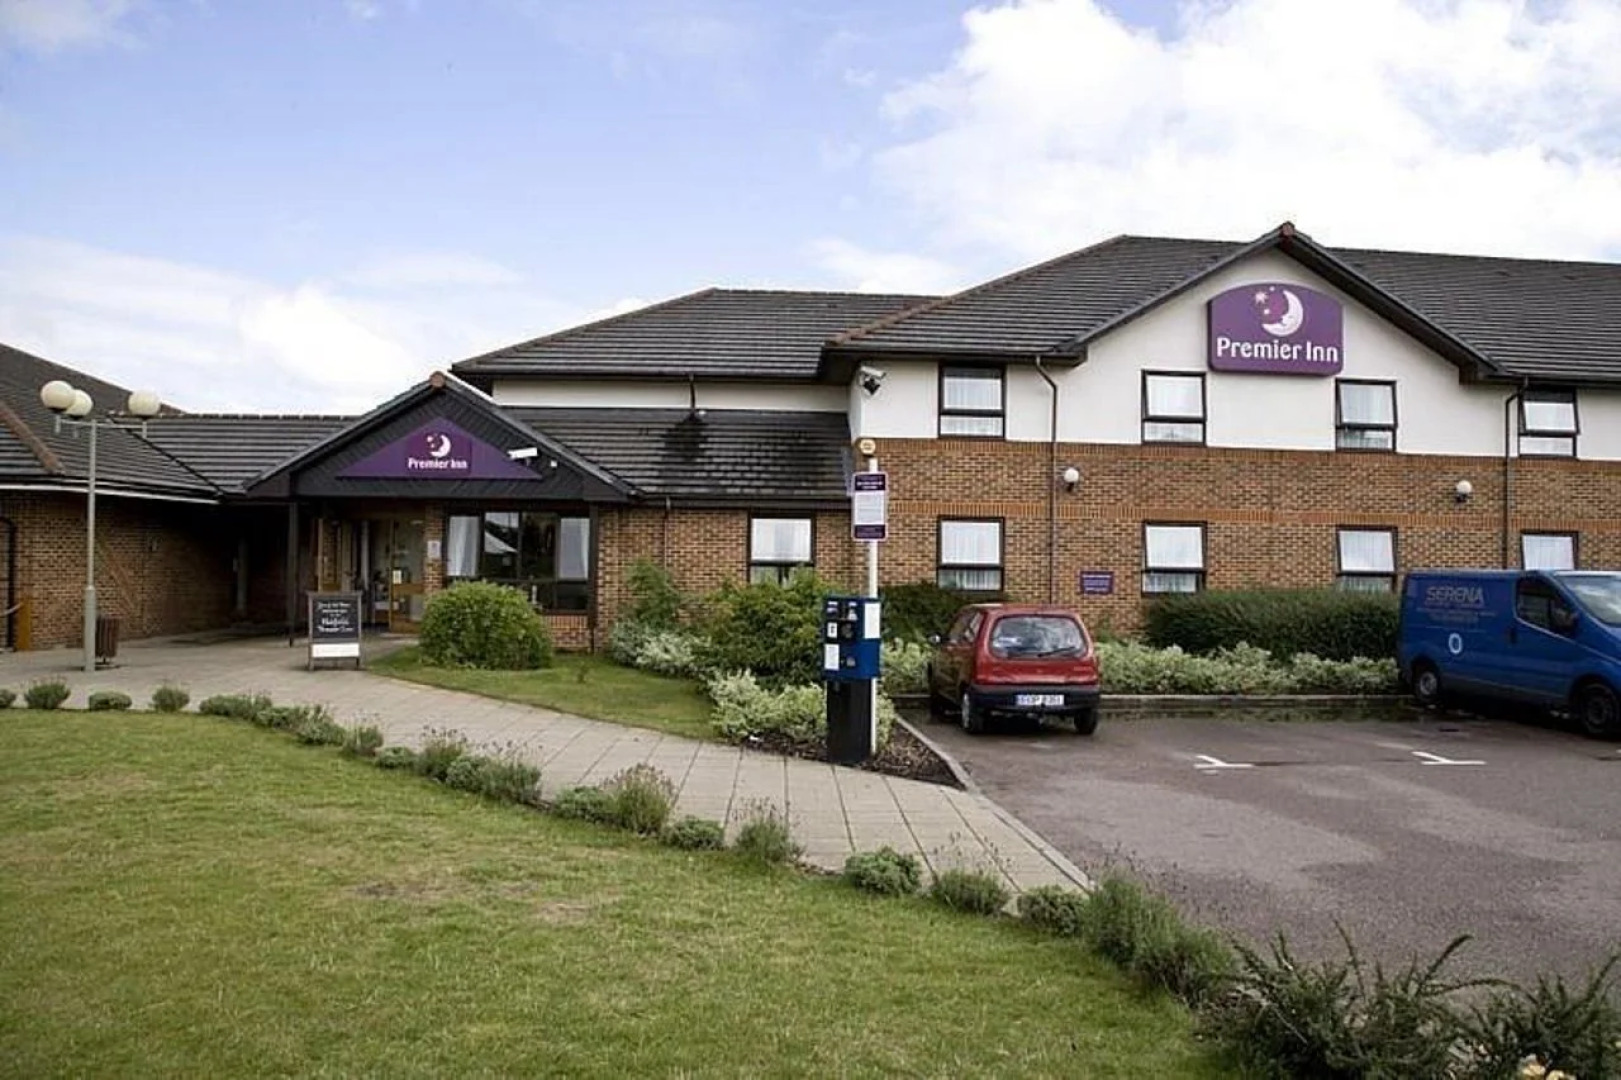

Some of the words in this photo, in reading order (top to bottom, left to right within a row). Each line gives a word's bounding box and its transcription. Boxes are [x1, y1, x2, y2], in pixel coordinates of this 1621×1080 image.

[1216, 337, 1302, 360] Premier
[1306, 341, 1339, 362] Inn
[408, 457, 448, 469] Premier
[451, 458, 468, 469] Inn
[1425, 586, 1484, 602] SERENA
